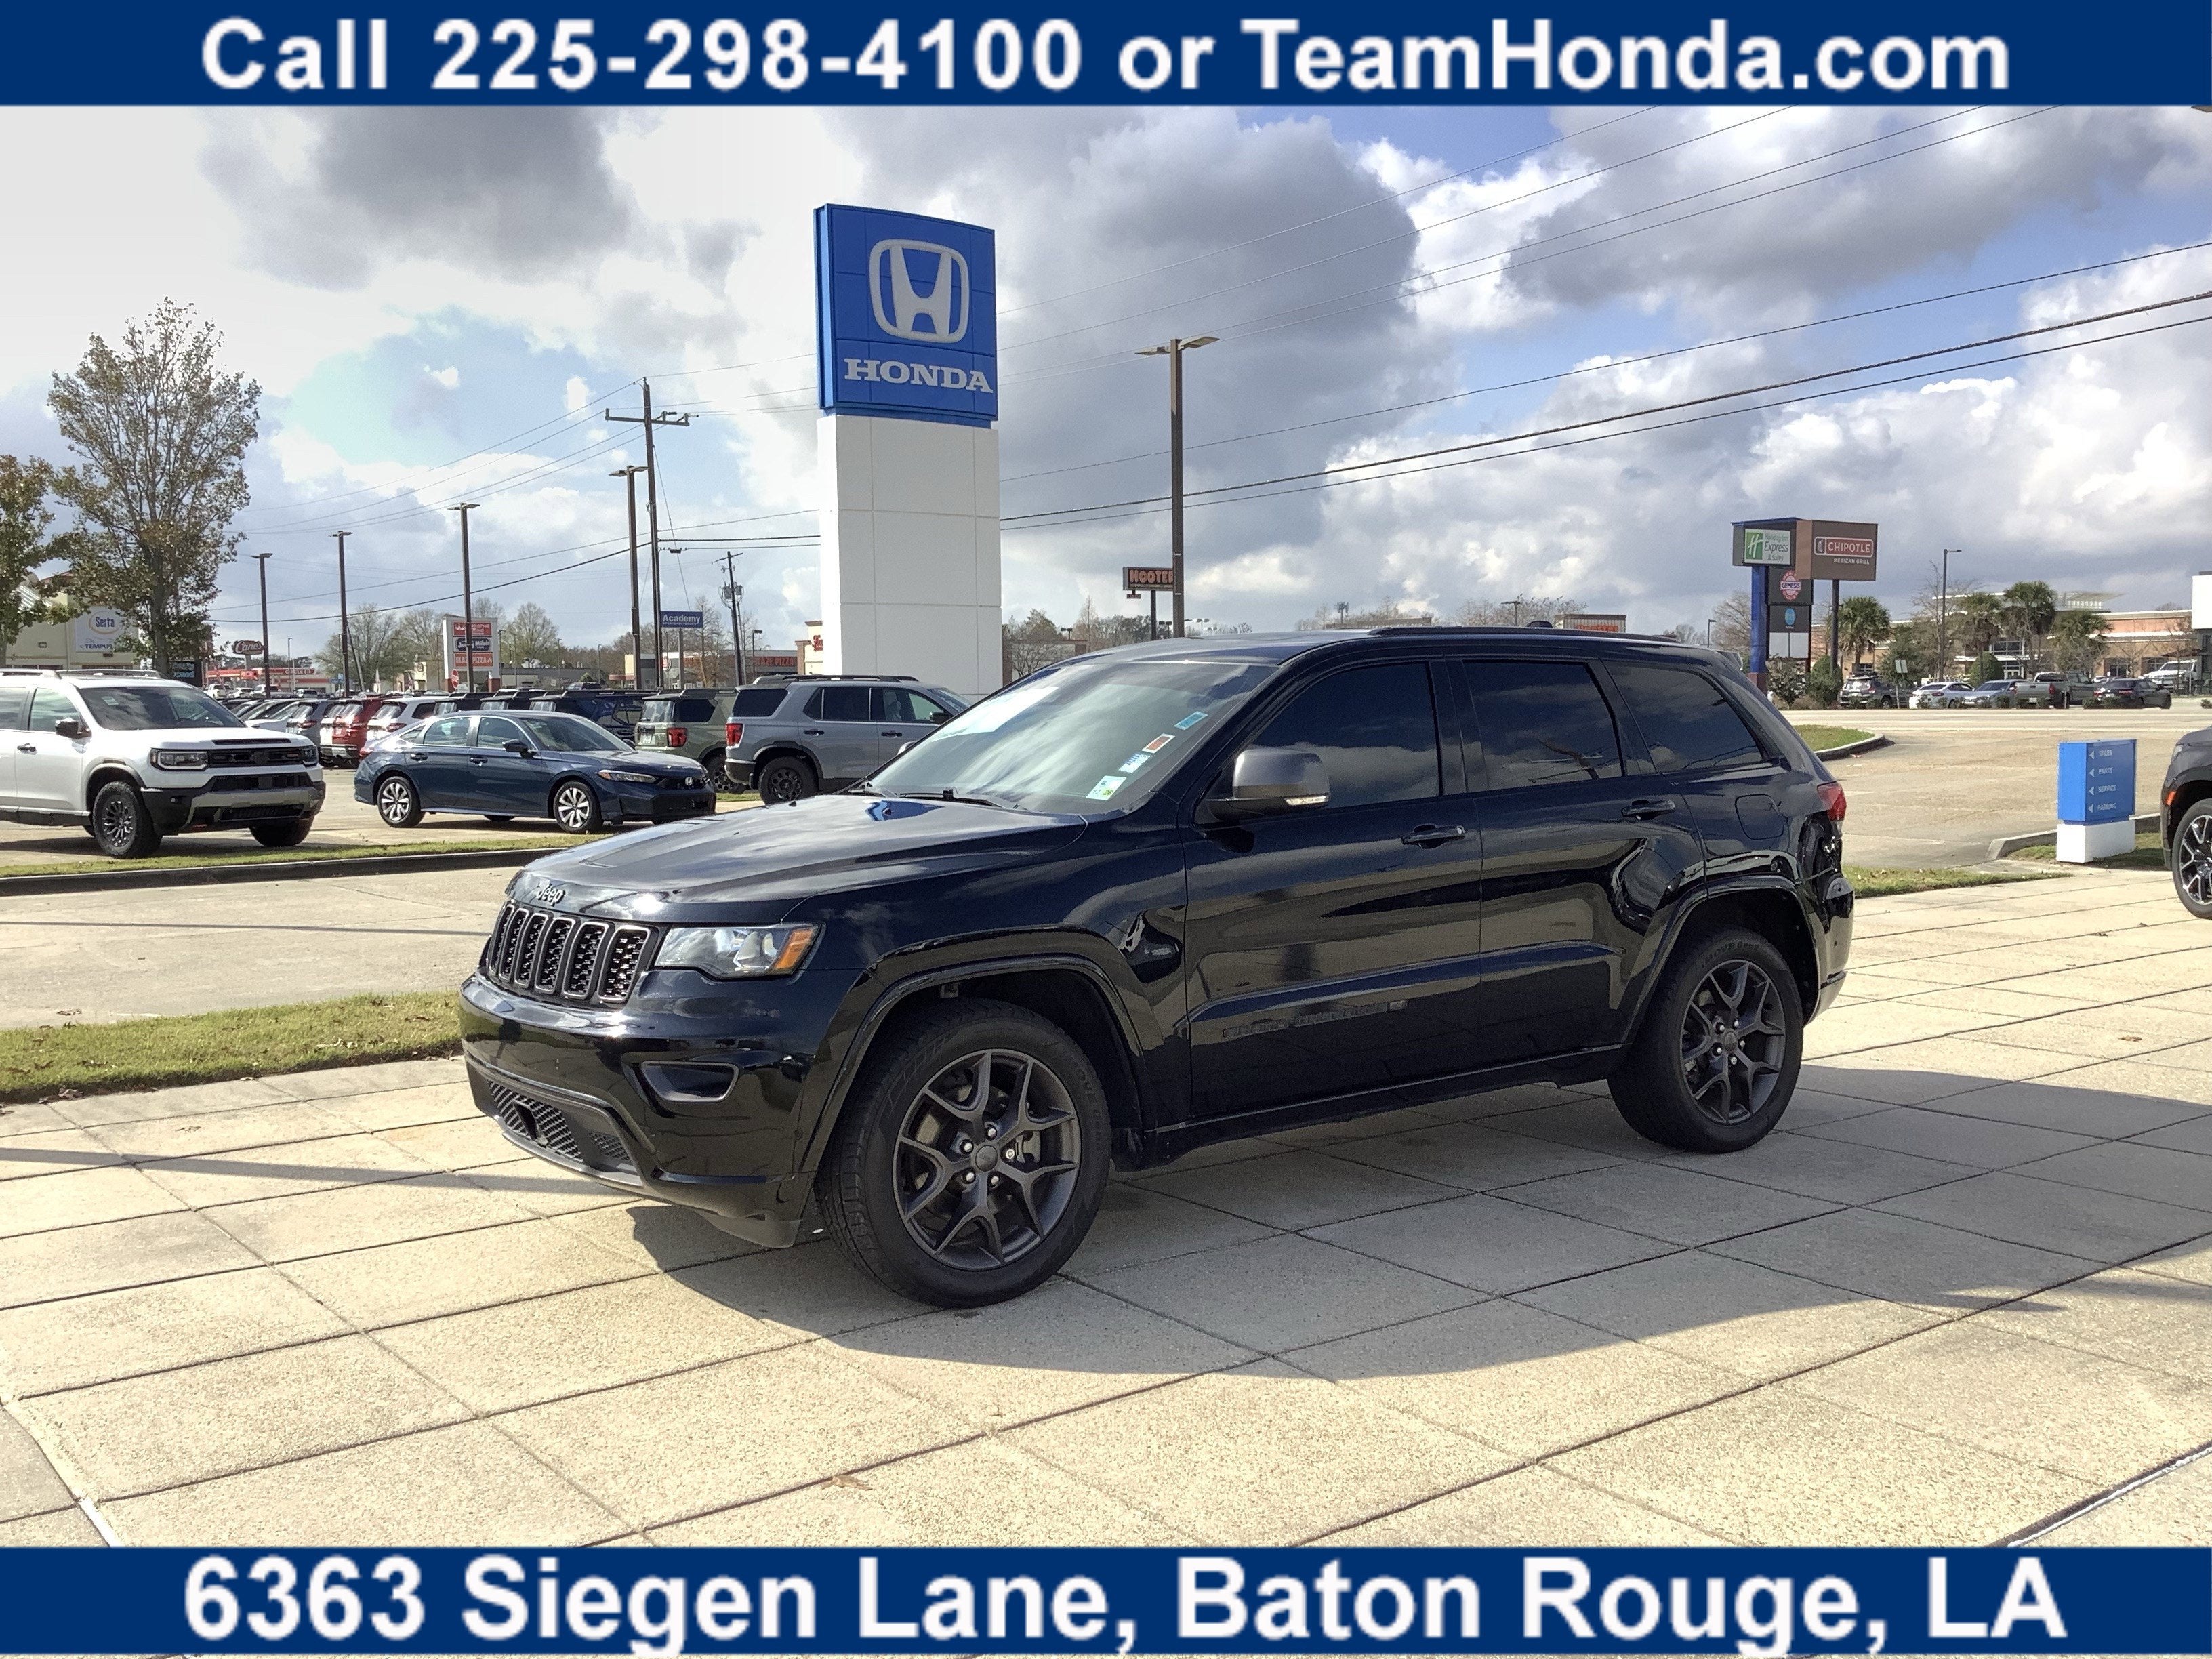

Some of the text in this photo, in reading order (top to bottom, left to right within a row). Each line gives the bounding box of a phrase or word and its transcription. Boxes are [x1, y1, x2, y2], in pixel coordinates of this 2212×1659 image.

[844, 357, 994, 394] HONDA
[1764, 541, 1788, 554] Express
[1827, 541, 1871, 553] CHIPOTLE
[95, 617, 115, 628] Serta
[663, 614, 701, 625] Academy
[536, 882, 565, 907] Jeep
